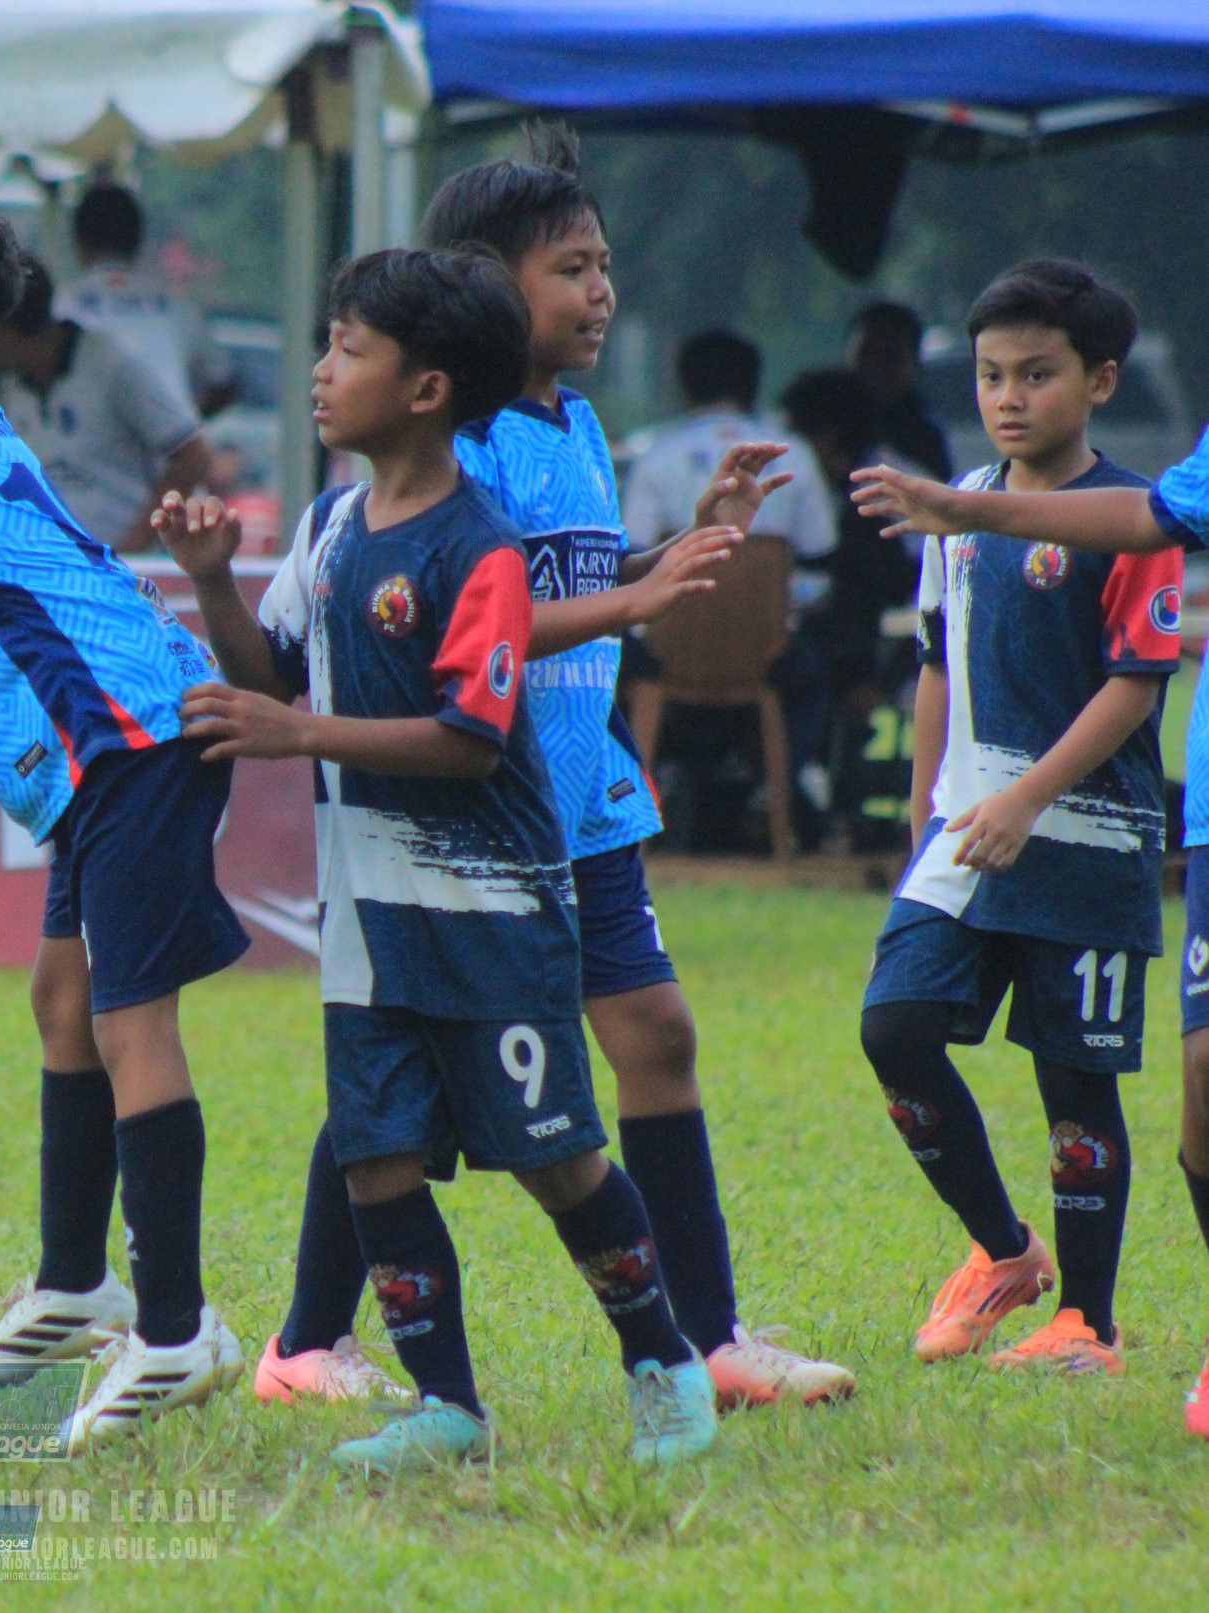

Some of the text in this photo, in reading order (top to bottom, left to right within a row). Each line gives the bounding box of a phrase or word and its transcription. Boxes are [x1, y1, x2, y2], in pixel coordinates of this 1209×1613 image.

[383, 623, 396, 633] FC
[1073, 949, 1127, 1022] 11
[498, 1025, 545, 1108] 9
